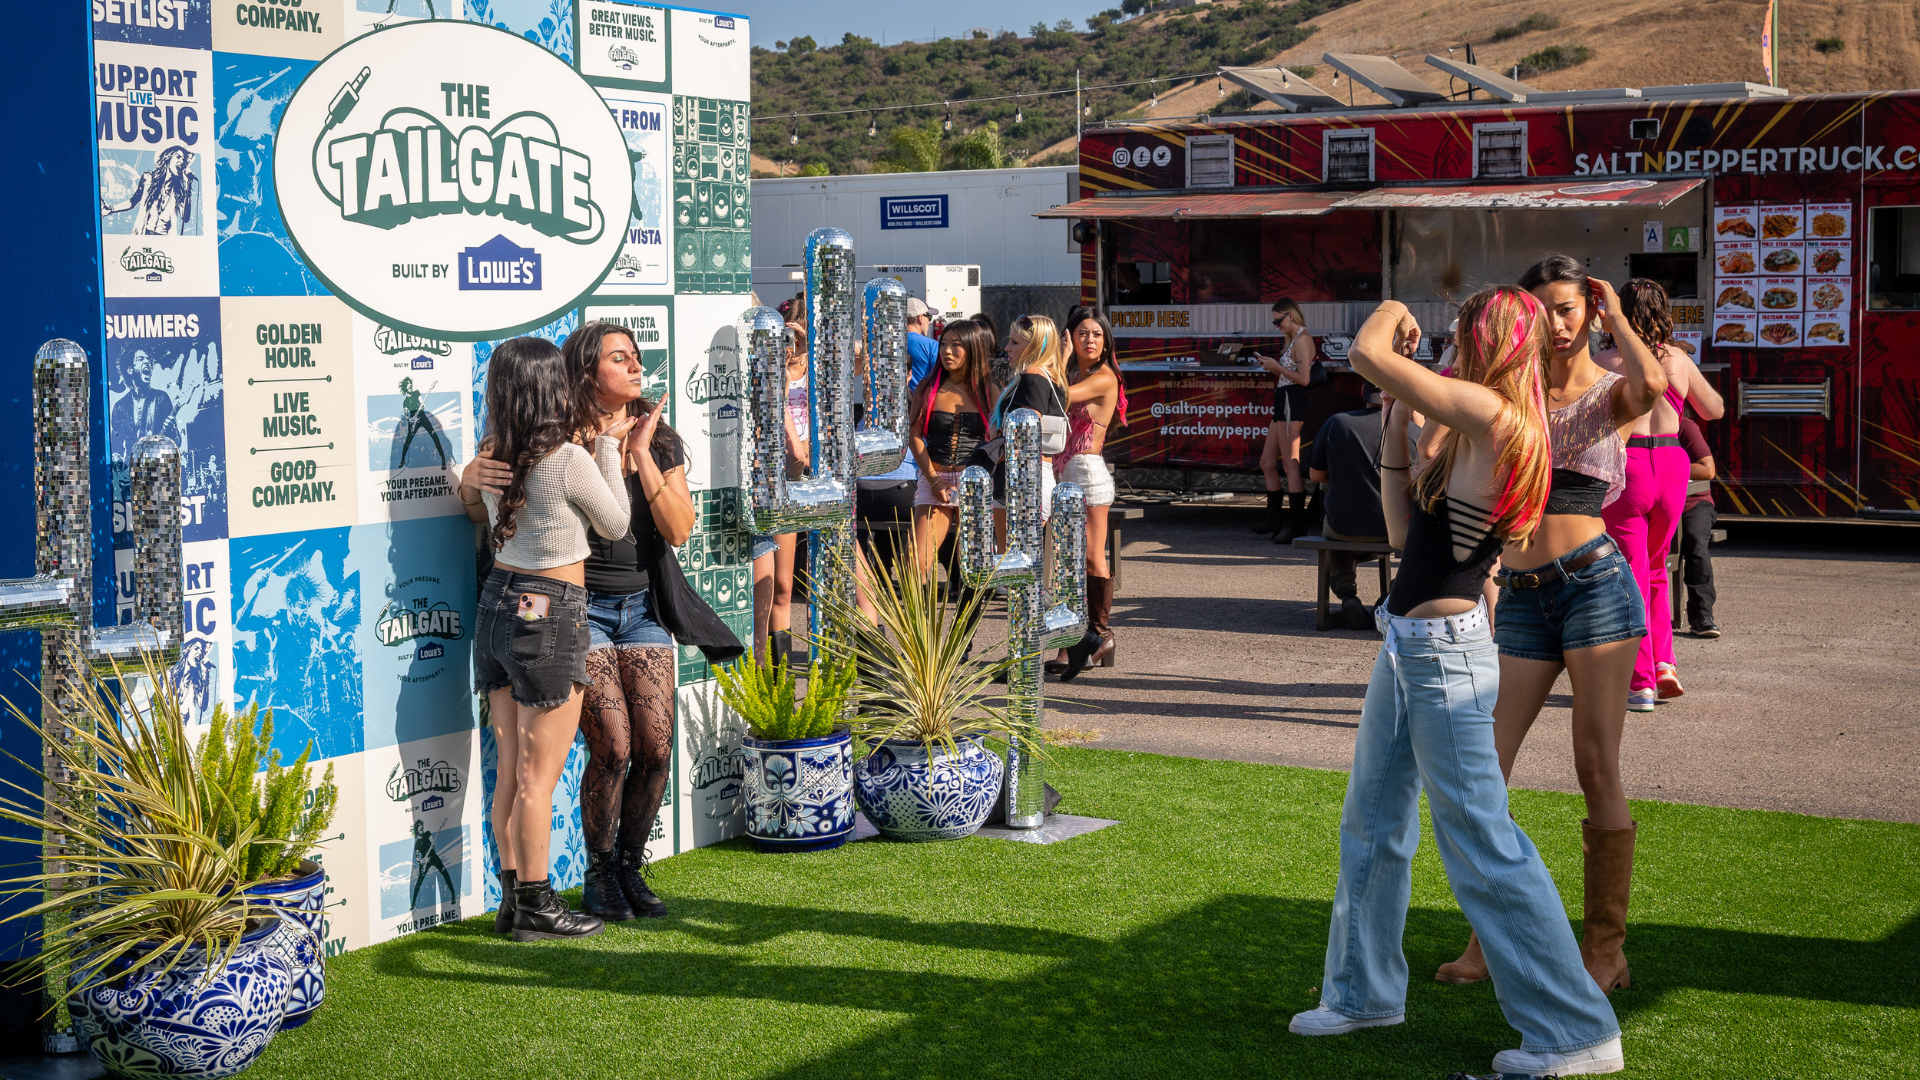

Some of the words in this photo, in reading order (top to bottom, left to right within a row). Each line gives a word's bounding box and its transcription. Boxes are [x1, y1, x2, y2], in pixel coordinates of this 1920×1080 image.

[93, 0, 188, 30] SETLIST
[236, 4, 322, 33] COMPANY.
[591, 8, 620, 24] GREAT
[622, 12, 654, 28] VIEWS.
[589, 23, 623, 39] BETTER
[625, 28, 657, 43] MUSIC.
[698, 33, 709, 44] YOUR
[610, 51, 638, 64] TAILGATE
[94, 63, 197, 97] UPPORT
[130, 91, 153, 105] LIVE
[440, 82, 490, 119] THE
[97, 101, 198, 145] MUSIC
[622, 109, 661, 132] FROM
[1574, 145, 1920, 176] SALTNPEPPERTRUCK.C
[330, 126, 591, 231] TAILGATE
[891, 204, 937, 214] WILLSCOT
[628, 229, 662, 245] VISTA
[1647, 228, 1658, 242] A
[1672, 233, 1685, 247] A
[123, 254, 172, 271] TAILGATE
[392, 264, 428, 278] BUILT
[432, 264, 449, 278] BY
[468, 256, 535, 284] LOWE'S
[614, 259, 641, 271] AILGATE
[105, 313, 200, 340] SUMMERS
[630, 317, 656, 329] VISTA
[1111, 311, 1155, 327] PICKUP
[1157, 311, 1189, 327] HERE
[256, 323, 322, 346] GOLDEN
[637, 330, 660, 343] MIND
[265, 346, 316, 368] HOUR.
[412, 360, 432, 369] LOWE'S
[714, 364, 726, 374] THE
[689, 375, 738, 404] TAILGA
[273, 391, 310, 414] LIVE
[1151, 401, 1274, 419] @saltnpeppertruc
[263, 414, 321, 438] MUSIC.
[1160, 421, 1269, 438] #crackmypeppe
[271, 459, 316, 482] GOOD
[385, 478, 408, 490] YOUR
[409, 475, 449, 489] PREGAME.
[252, 481, 336, 508] COMPANY.
[380, 490, 403, 502] YOUR
[403, 486, 454, 500] AFTERPARTY.
[398, 579, 414, 589] YOUR
[414, 575, 442, 584] PREGAME.
[412, 597, 428, 609] THE
[380, 610, 460, 645] TAILGATE
[420, 647, 442, 659] LOWE'S
[396, 674, 411, 683] YOUR
[412, 667, 446, 683] AFTERPARTY.
[717, 745, 728, 756] THE
[417, 758, 430, 769] THE
[693, 755, 744, 788] TAILGAT
[390, 768, 458, 800] TAILGATE
[722, 787, 738, 798] LOWE'S
[424, 800, 442, 810] LOWE'S
[397, 919, 418, 934] YOUR
[419, 909, 458, 928] PREGAME.
